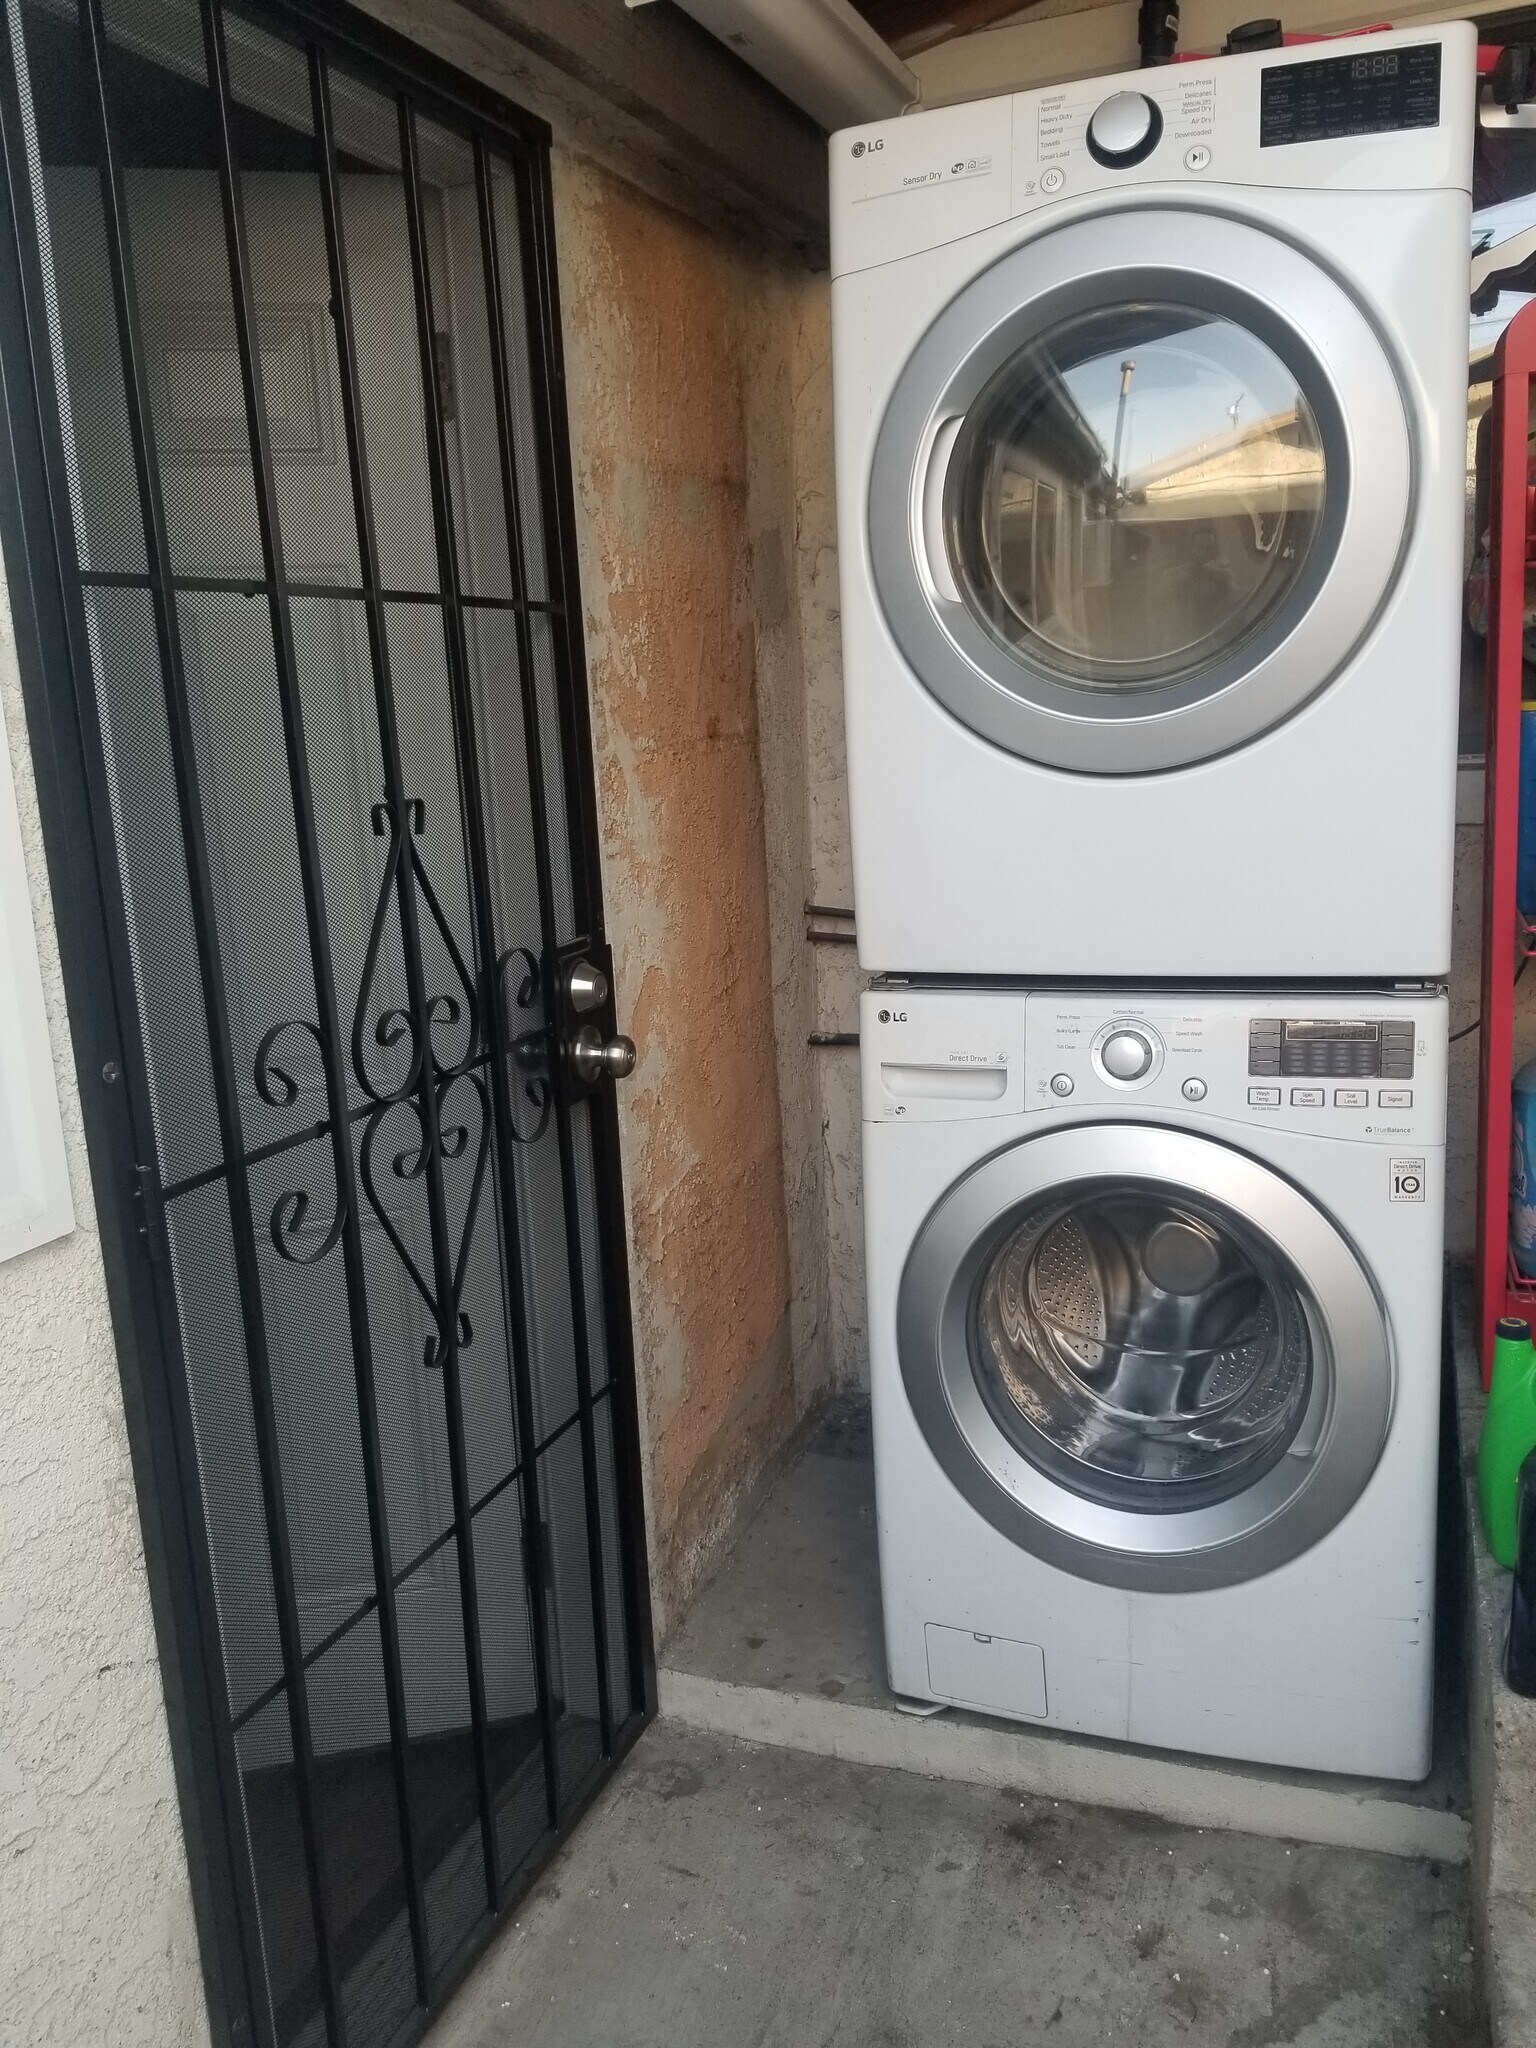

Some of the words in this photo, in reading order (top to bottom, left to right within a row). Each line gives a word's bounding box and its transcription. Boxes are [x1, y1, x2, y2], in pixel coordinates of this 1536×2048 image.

[1184, 90, 1212, 100] Delicates
[1040, 104, 1062, 112] Normal
[1181, 106, 1200, 115] Speed
[1040, 116, 1058, 124] Heavy
[1040, 126, 1064, 136] Bedding
[1174, 129, 1212, 139] Downloaded
[868, 139, 884, 152] LG
[1040, 154, 1056, 162] Small
[1056, 150, 1070, 158] Load
[902, 174, 928, 186] Sensor
[930, 171, 942, 180] Dry
[893, 1012, 908, 1022] LG
[949, 1054, 969, 1062] Direct
[1394, 1176, 1420, 1194] 10
